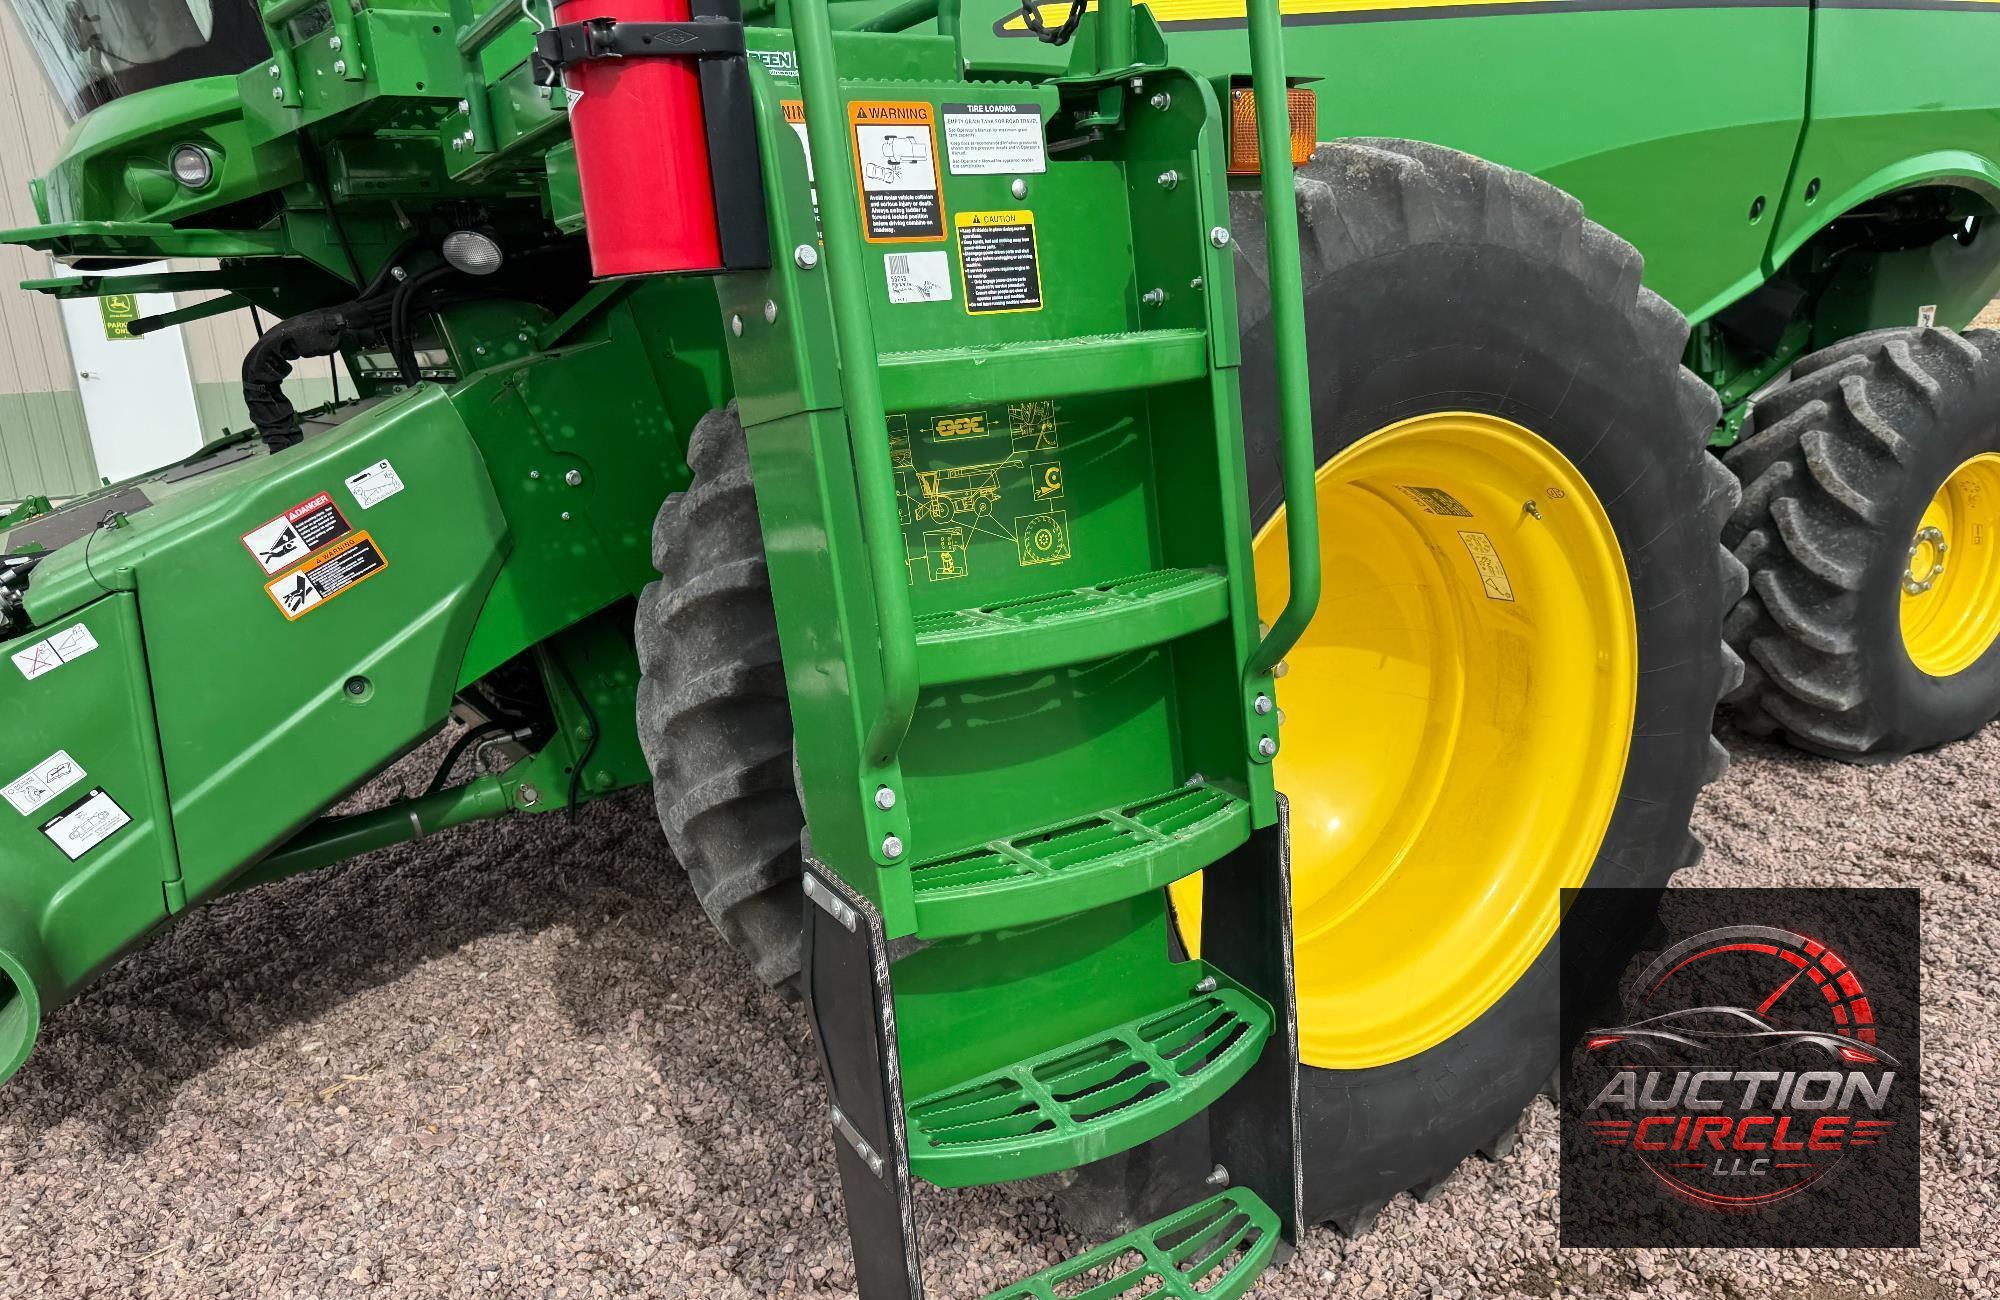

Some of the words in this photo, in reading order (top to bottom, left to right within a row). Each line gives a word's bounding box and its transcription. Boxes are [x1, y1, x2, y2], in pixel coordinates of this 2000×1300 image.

[868, 107, 928, 120] WARNING
[984, 215, 1016, 223] CAUTION
[295, 495, 328, 516] DANGER
[322, 540, 355, 560] WARNING
